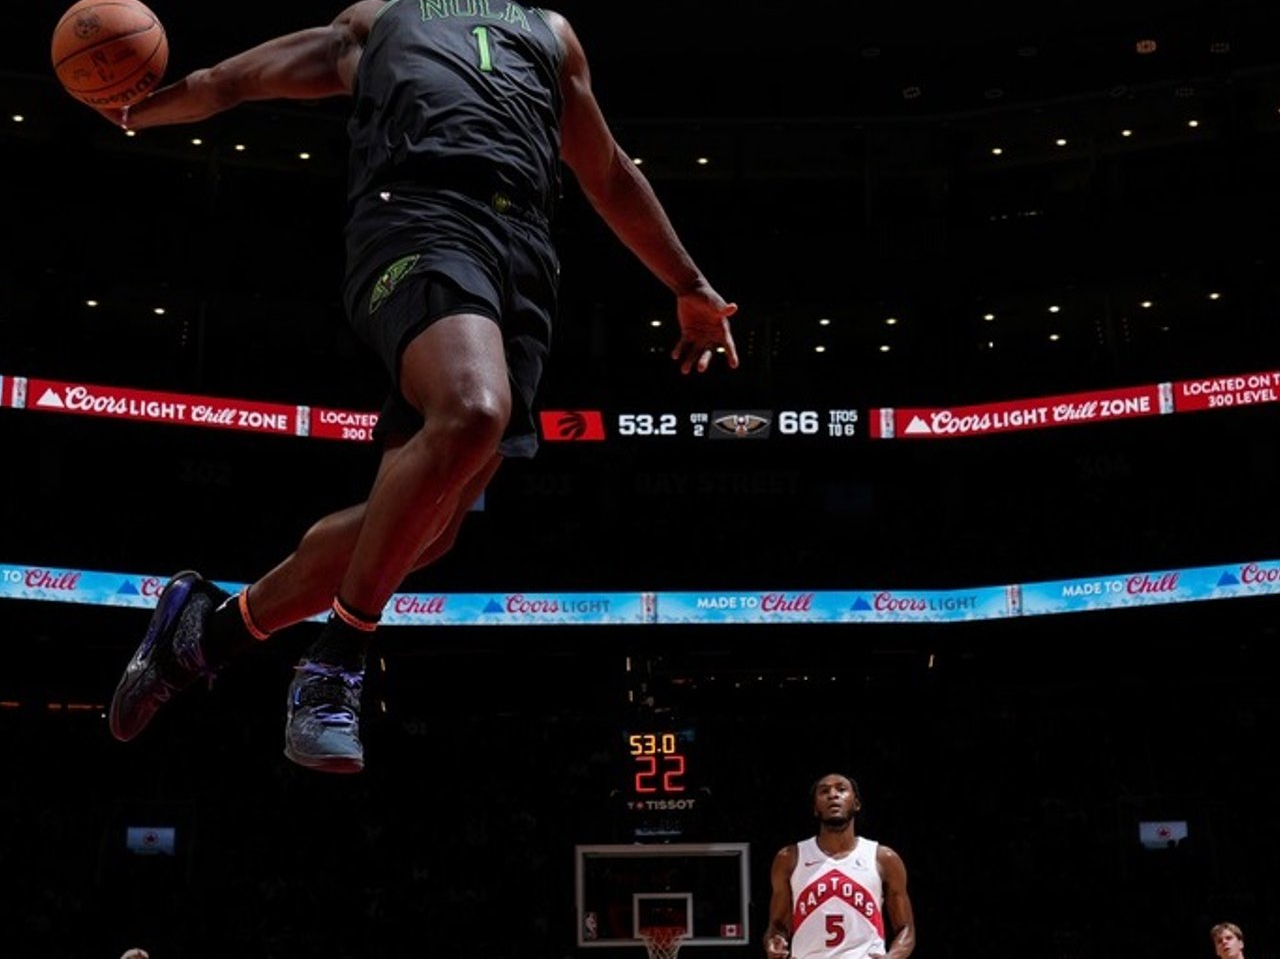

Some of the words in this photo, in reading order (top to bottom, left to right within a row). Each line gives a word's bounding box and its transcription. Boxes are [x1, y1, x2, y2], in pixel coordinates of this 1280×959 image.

[472, 26, 493, 72] 1
[1183, 378, 1246, 396] LOCATED
[1249, 374, 1270, 389] ON
[65, 386, 129, 414] Coors
[130, 399, 186, 420] LIGHT
[191, 404, 237, 425] Chill
[238, 411, 288, 430] ZONE
[1208, 392, 1233, 408] 300
[1236, 388, 1277, 405] LEVEL
[320, 410, 379, 427] LOCATED
[619, 414, 678, 436] 53.2
[778, 411, 819, 434] 66
[931, 410, 992, 434] Coors
[993, 408, 1048, 428] LIGHT
[1053, 401, 1098, 420] Chill
[1100, 396, 1150, 416] ZONE
[342, 427, 366, 440] 300
[693, 426, 704, 436] 2
[3, 570, 22, 582] TO
[24, 569, 81, 591] Chill
[1062, 581, 1102, 597] MADE
[1104, 580, 1122, 593] TO
[1124, 572, 1180, 596] Chill
[394, 594, 447, 614] Chill
[505, 594, 559, 614] Coors
[561, 599, 610, 613] LIGHT
[630, 734, 675, 755] 53.0
[635, 756, 685, 792] 22
[646, 799, 695, 810] TISSOT
[799, 877, 874, 917] RAPTORS
[825, 915, 846, 947] 5
